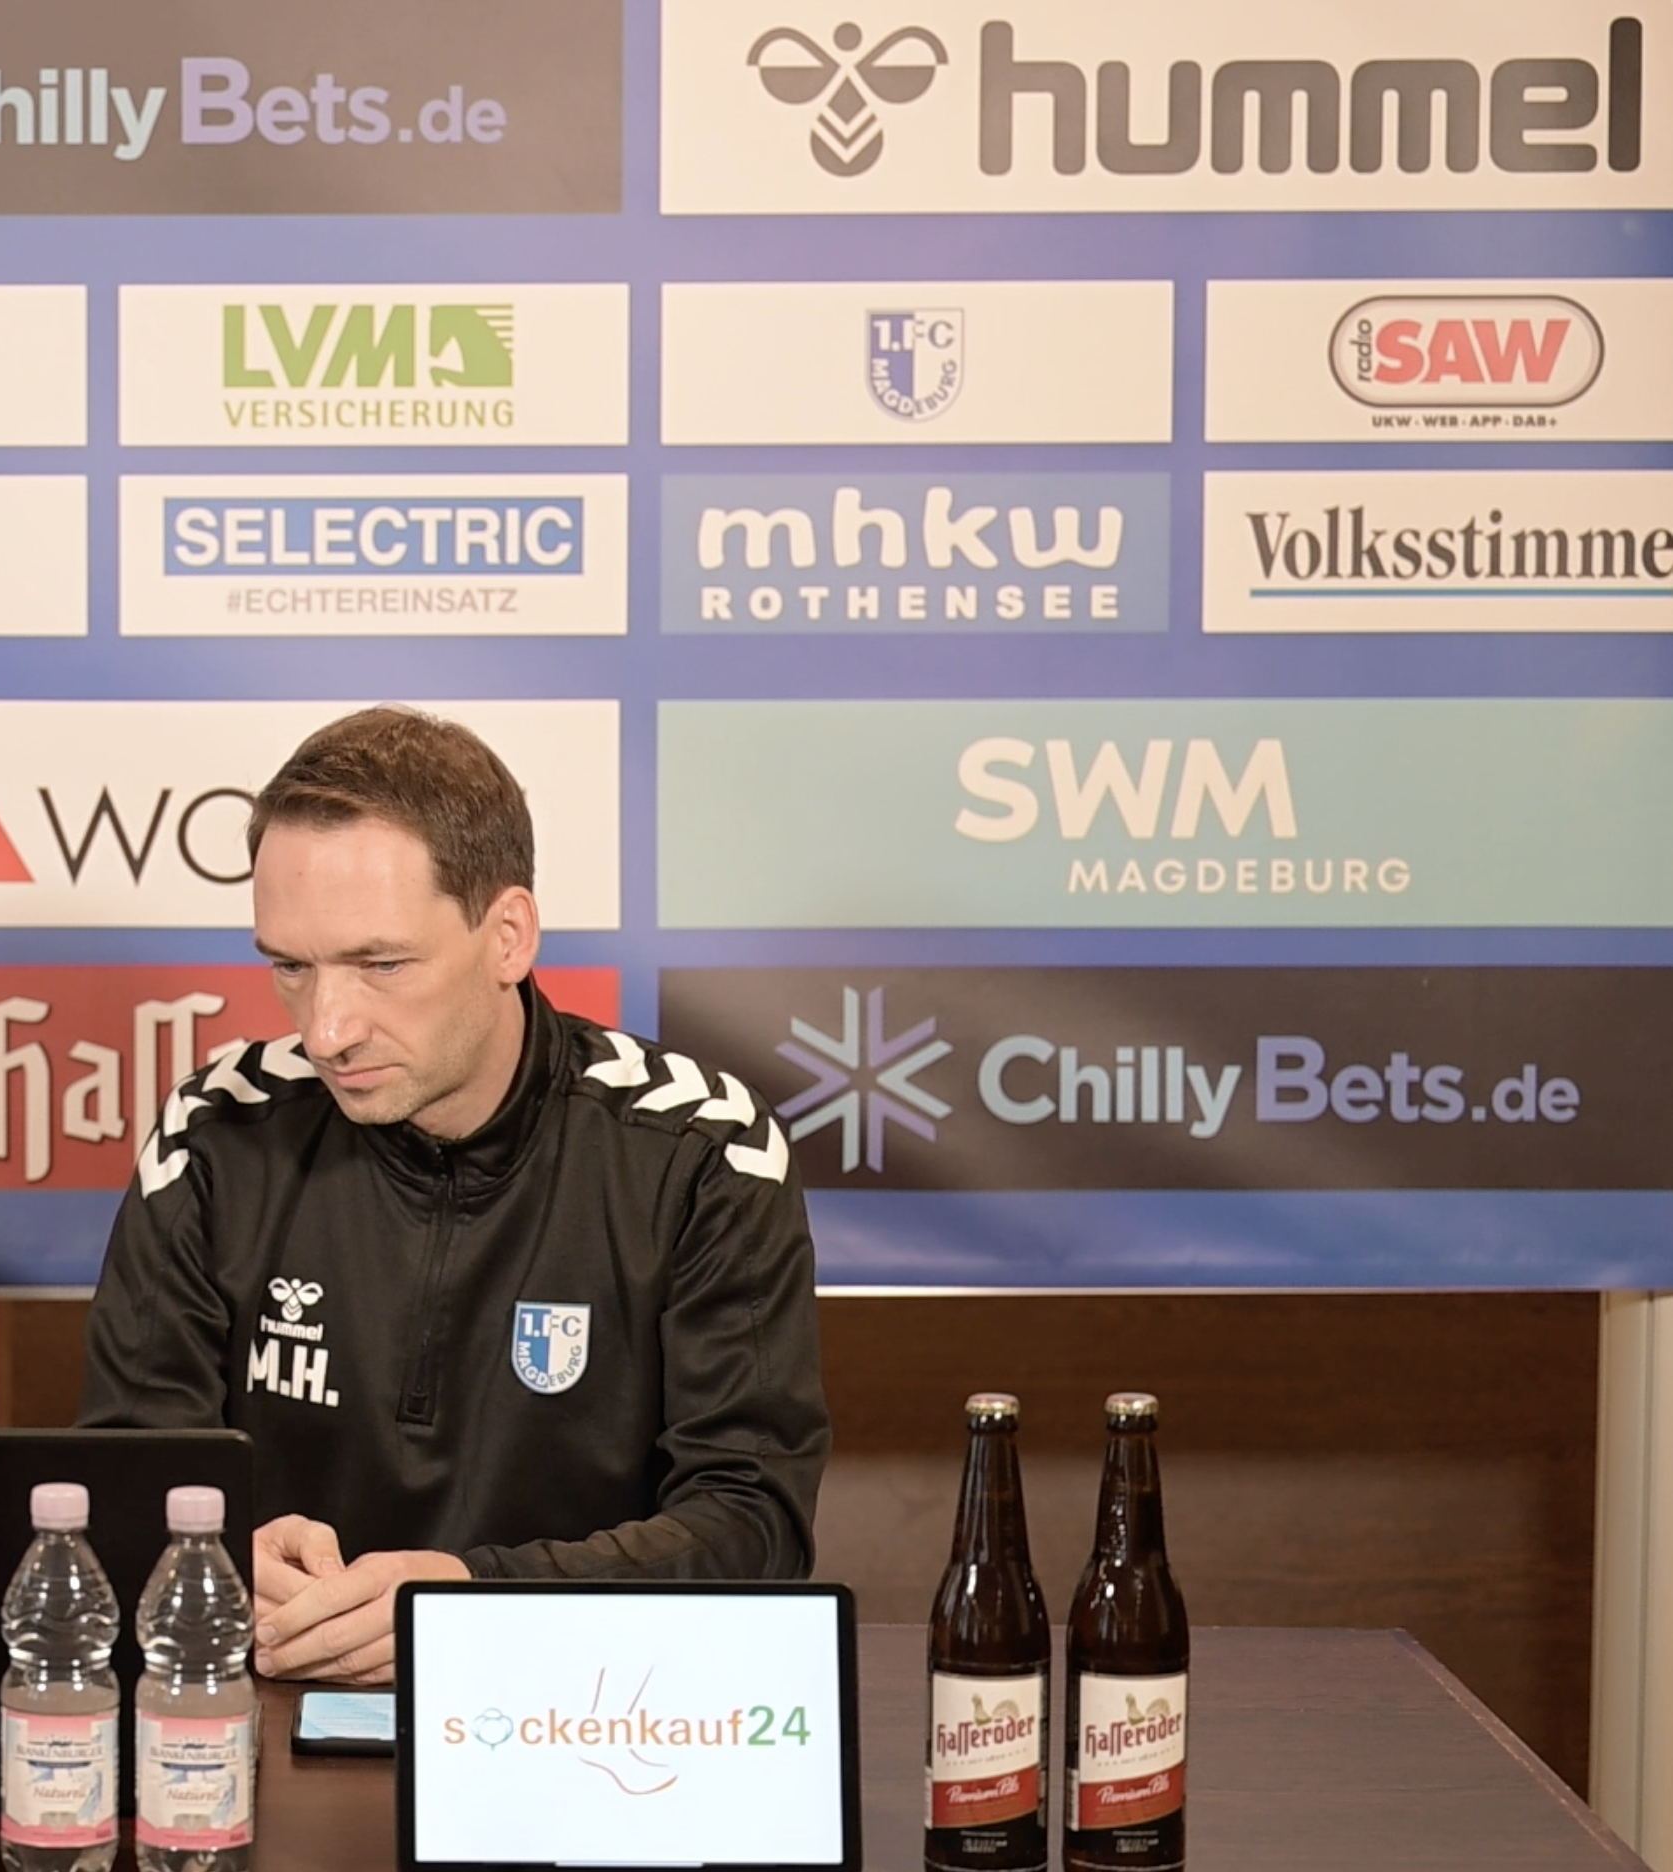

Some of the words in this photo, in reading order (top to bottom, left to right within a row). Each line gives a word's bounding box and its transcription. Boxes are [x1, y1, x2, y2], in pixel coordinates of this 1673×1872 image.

[979, 16, 1643, 176] hummel
[223, 304, 416, 388] LVM
[1349, 319, 1373, 382] radio
[1374, 319, 1571, 384] SAW
[225, 400, 515, 428] VERSICHERUNG
[1371, 415, 1412, 428] UKW
[1422, 415, 1459, 428] WEB
[1469, 415, 1502, 428] APP
[174, 507, 573, 566] SELECTRIC
[698, 487, 1122, 570] mhkw
[1247, 506, 1673, 581] Volksstimme
[227, 588, 518, 613] #ECHTEREINSATZ
[702, 586, 1119, 620] ROTHENSEE
[954, 736, 1297, 842] SWM
[38, 785, 254, 887] WO
[1068, 859, 1412, 894] MAGDEBURG
[260, 1313, 324, 1342] hummel
[247, 1338, 339, 1407] M.H.
[518, 1342, 582, 1388] MAGDEBURG
